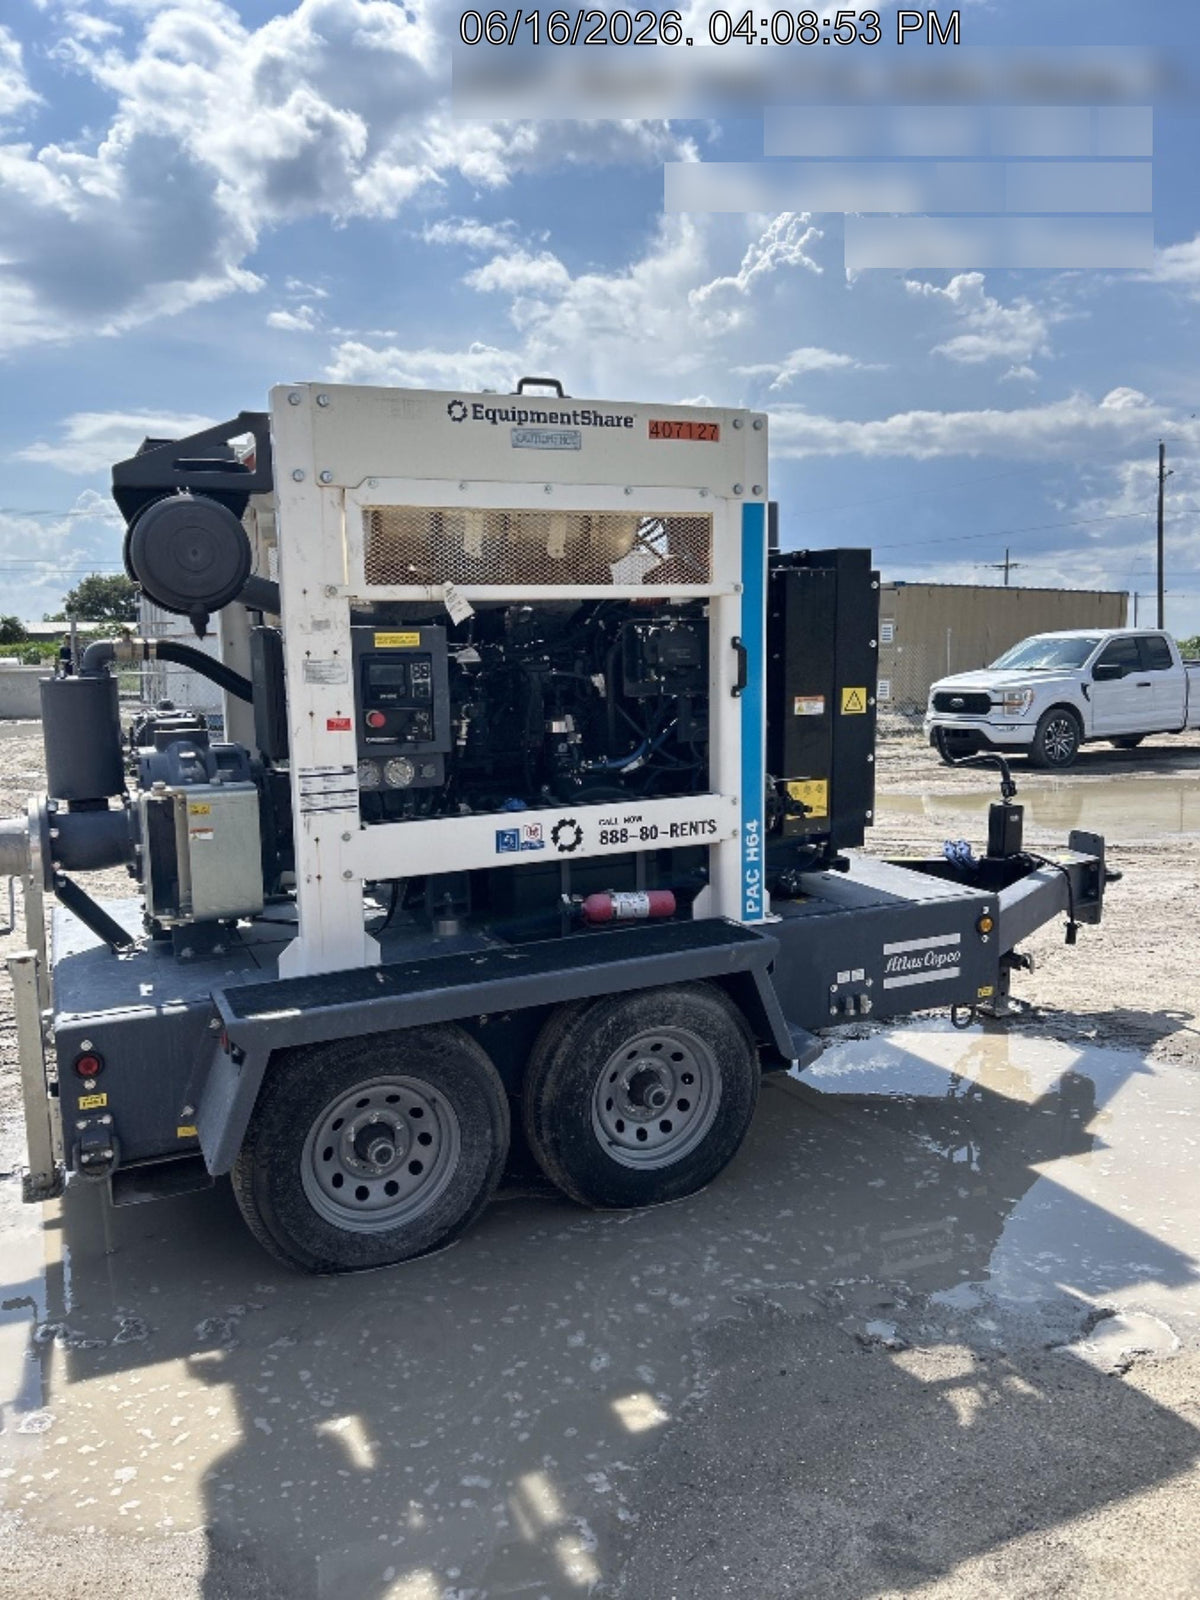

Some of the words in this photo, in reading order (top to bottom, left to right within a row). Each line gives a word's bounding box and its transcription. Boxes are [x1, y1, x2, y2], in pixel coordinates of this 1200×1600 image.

[472, 403, 634, 428] EquipmentShare
[650, 421, 718, 440] 407127
[598, 817, 618, 826] CALL
[623, 815, 643, 824] NOW
[599, 819, 717, 845] 888-80-RENTS
[746, 819, 760, 862] H64
[746, 869, 760, 913] PAC
[884, 955, 921, 973] Atlas
[924, 950, 961, 968] Copco
